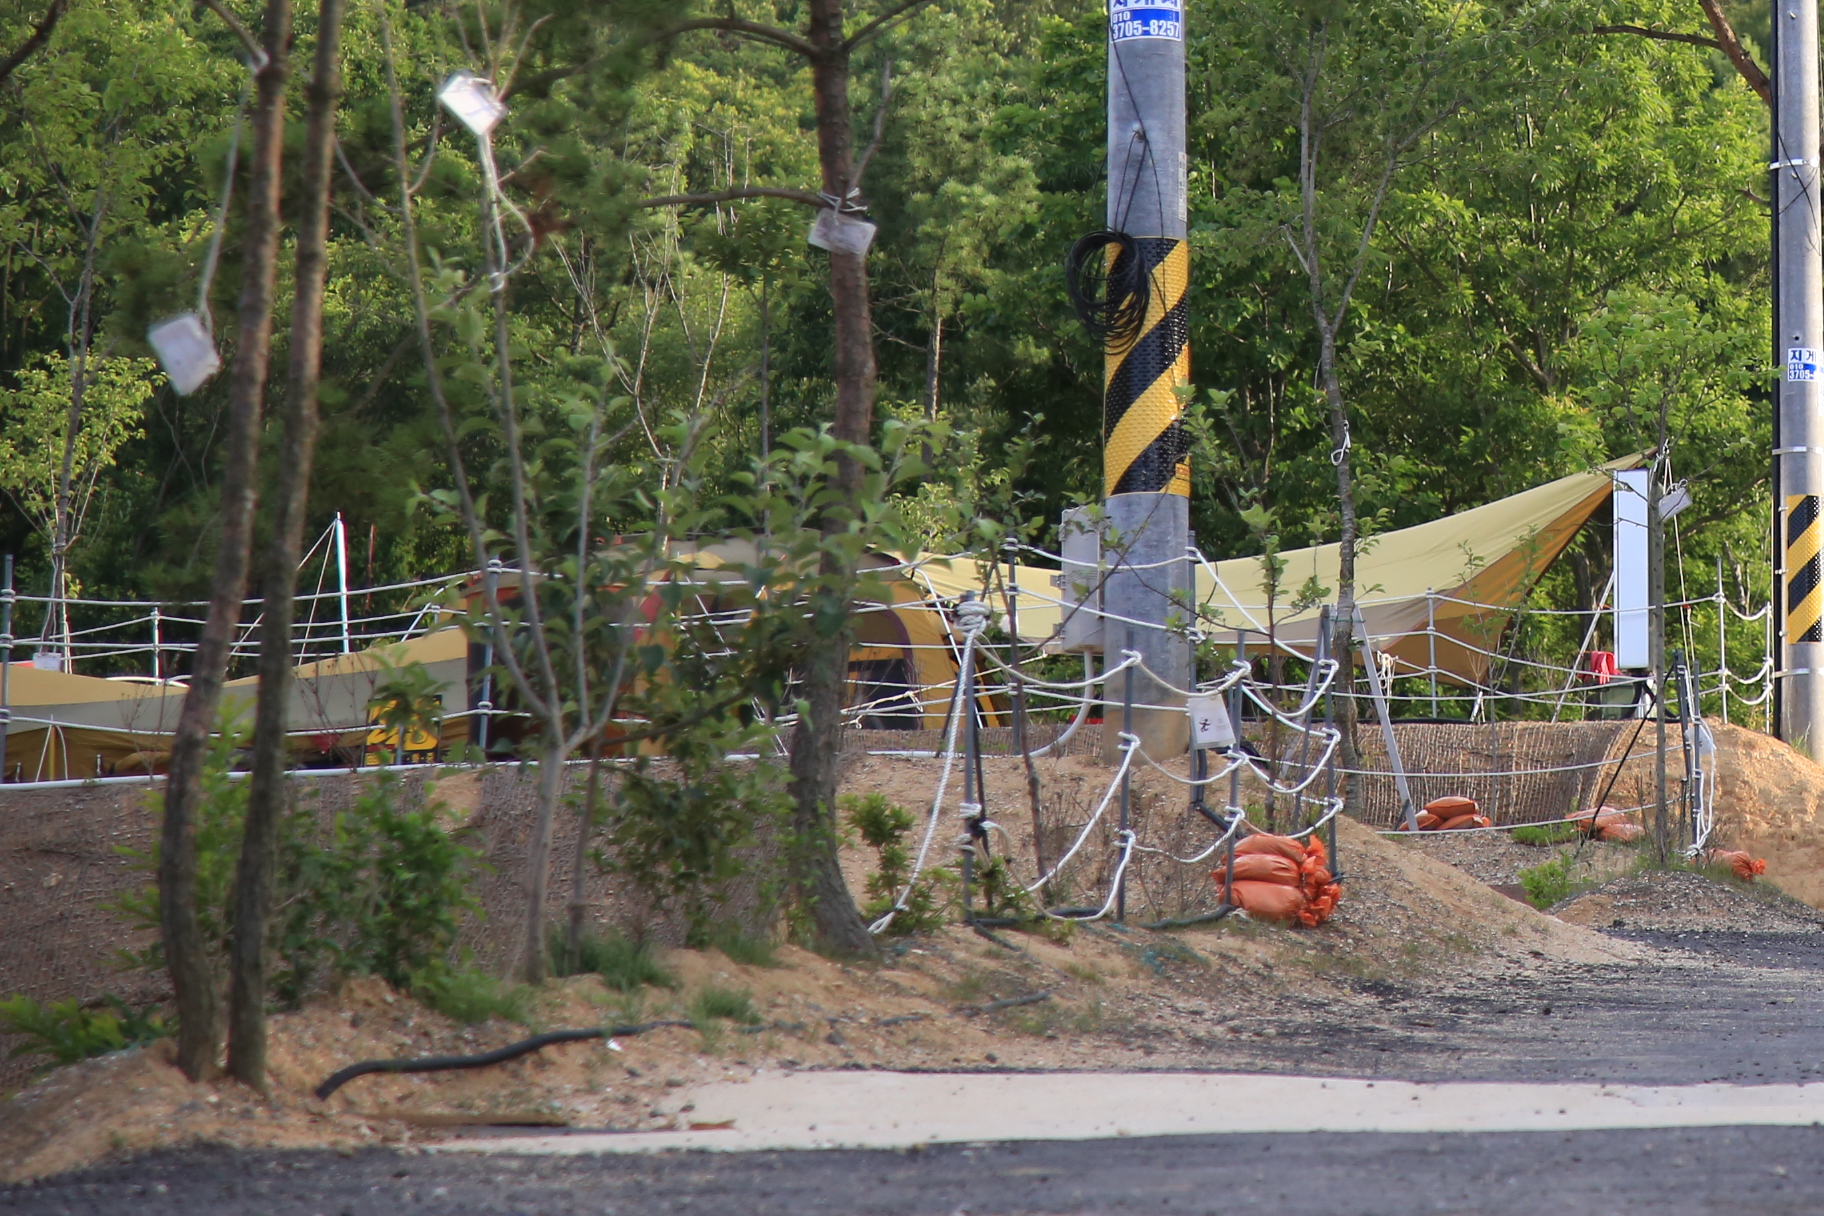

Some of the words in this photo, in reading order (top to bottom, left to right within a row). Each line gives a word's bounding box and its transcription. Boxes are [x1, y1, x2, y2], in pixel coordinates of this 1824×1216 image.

[1113, 11, 1131, 23] 010
[1113, 19, 1179, 39] 3705-8257
[1790, 349, 1817, 362] 지게
